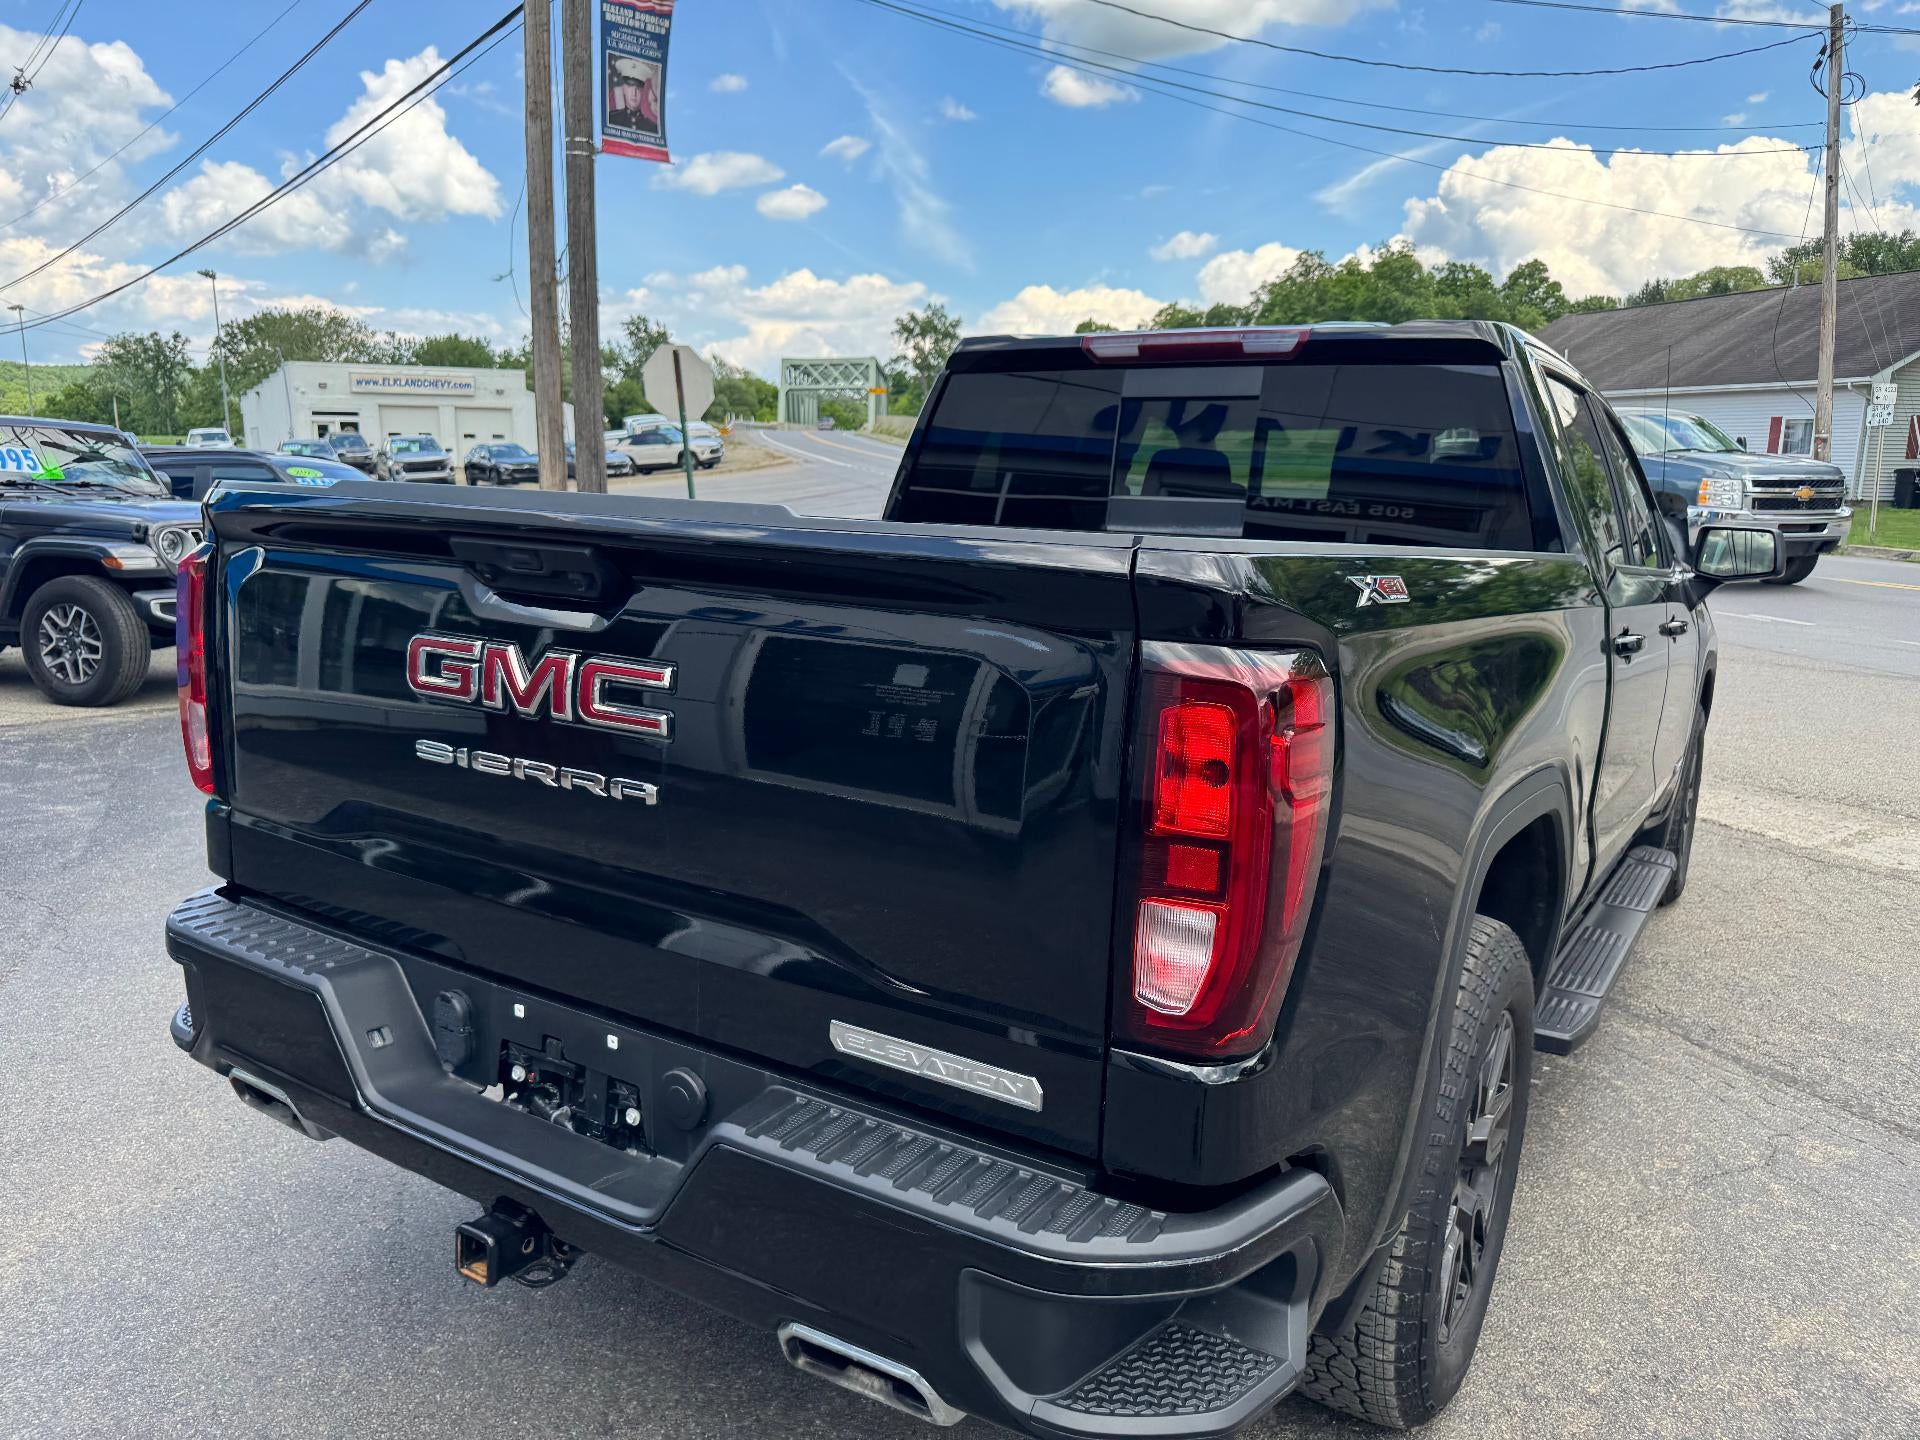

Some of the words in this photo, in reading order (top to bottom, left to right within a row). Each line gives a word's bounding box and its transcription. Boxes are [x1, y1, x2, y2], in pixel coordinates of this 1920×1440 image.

[356, 377, 472, 390] www.ELKLANDCHEVY.com
[407, 634, 676, 738] GMC
[415, 739, 659, 805] SIERRA
[847, 1033, 1025, 1094] ELEVATION
